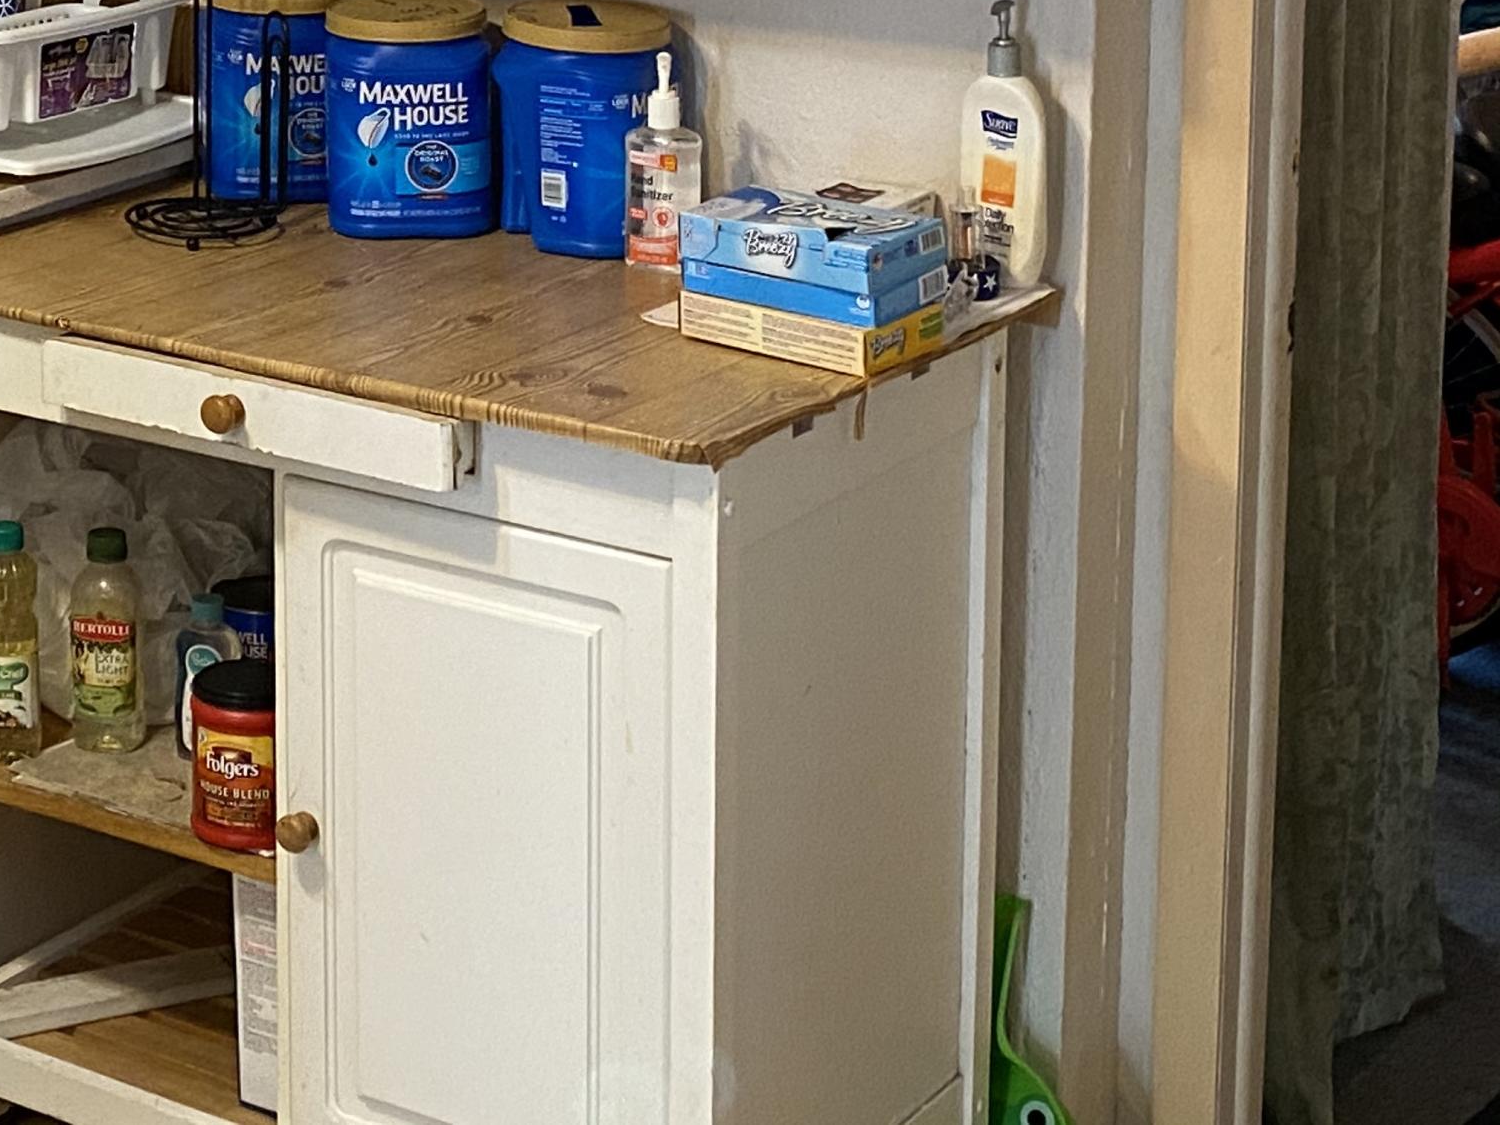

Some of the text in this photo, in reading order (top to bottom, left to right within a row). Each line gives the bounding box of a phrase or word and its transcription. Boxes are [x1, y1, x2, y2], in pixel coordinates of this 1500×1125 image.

[359, 81, 469, 104] MAXWELL
[393, 104, 469, 131] HOUSE
[985, 112, 1017, 130] Suave
[73, 620, 130, 636] BERTOLLI
[95, 652, 130, 665] EXTRA
[96, 664, 128, 675] LIGHT
[206, 751, 260, 779] Folgers
[233, 787, 270, 800] BLEND
